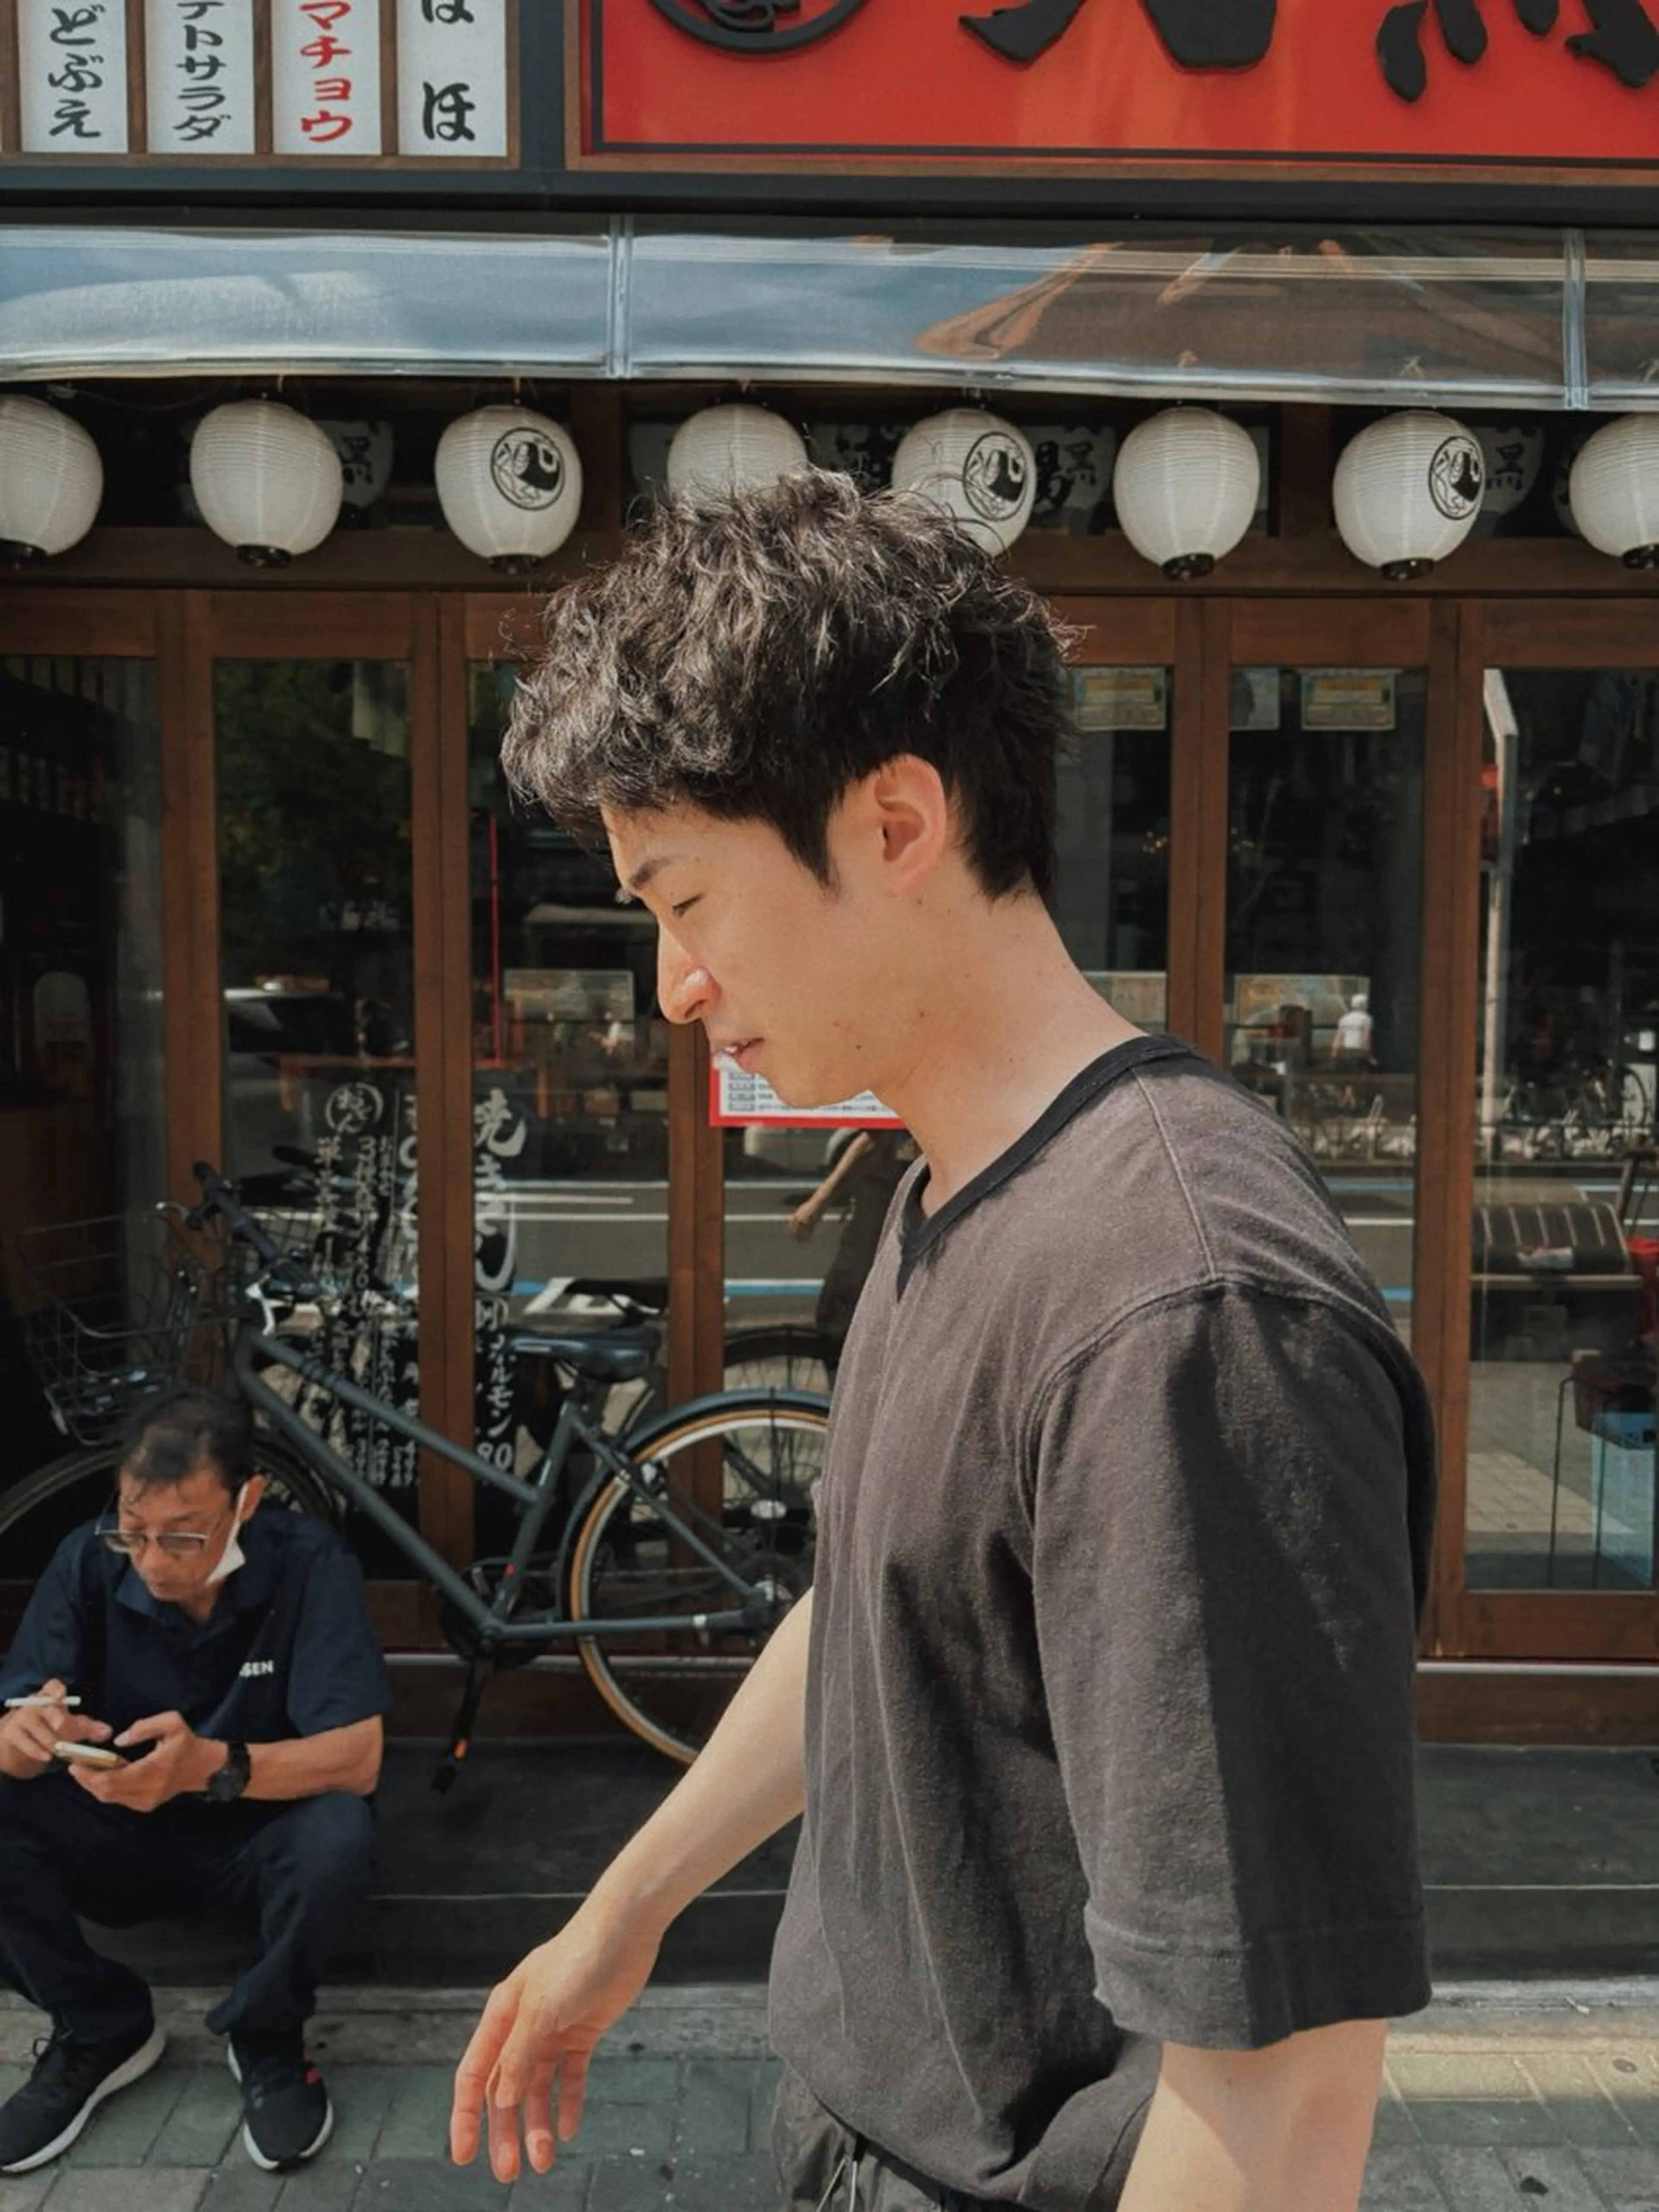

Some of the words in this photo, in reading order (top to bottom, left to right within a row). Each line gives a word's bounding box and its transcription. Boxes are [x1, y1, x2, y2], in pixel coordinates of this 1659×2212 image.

[48, 4, 106, 139] どぶえ
[300, 1, 352, 143] マチョウ
